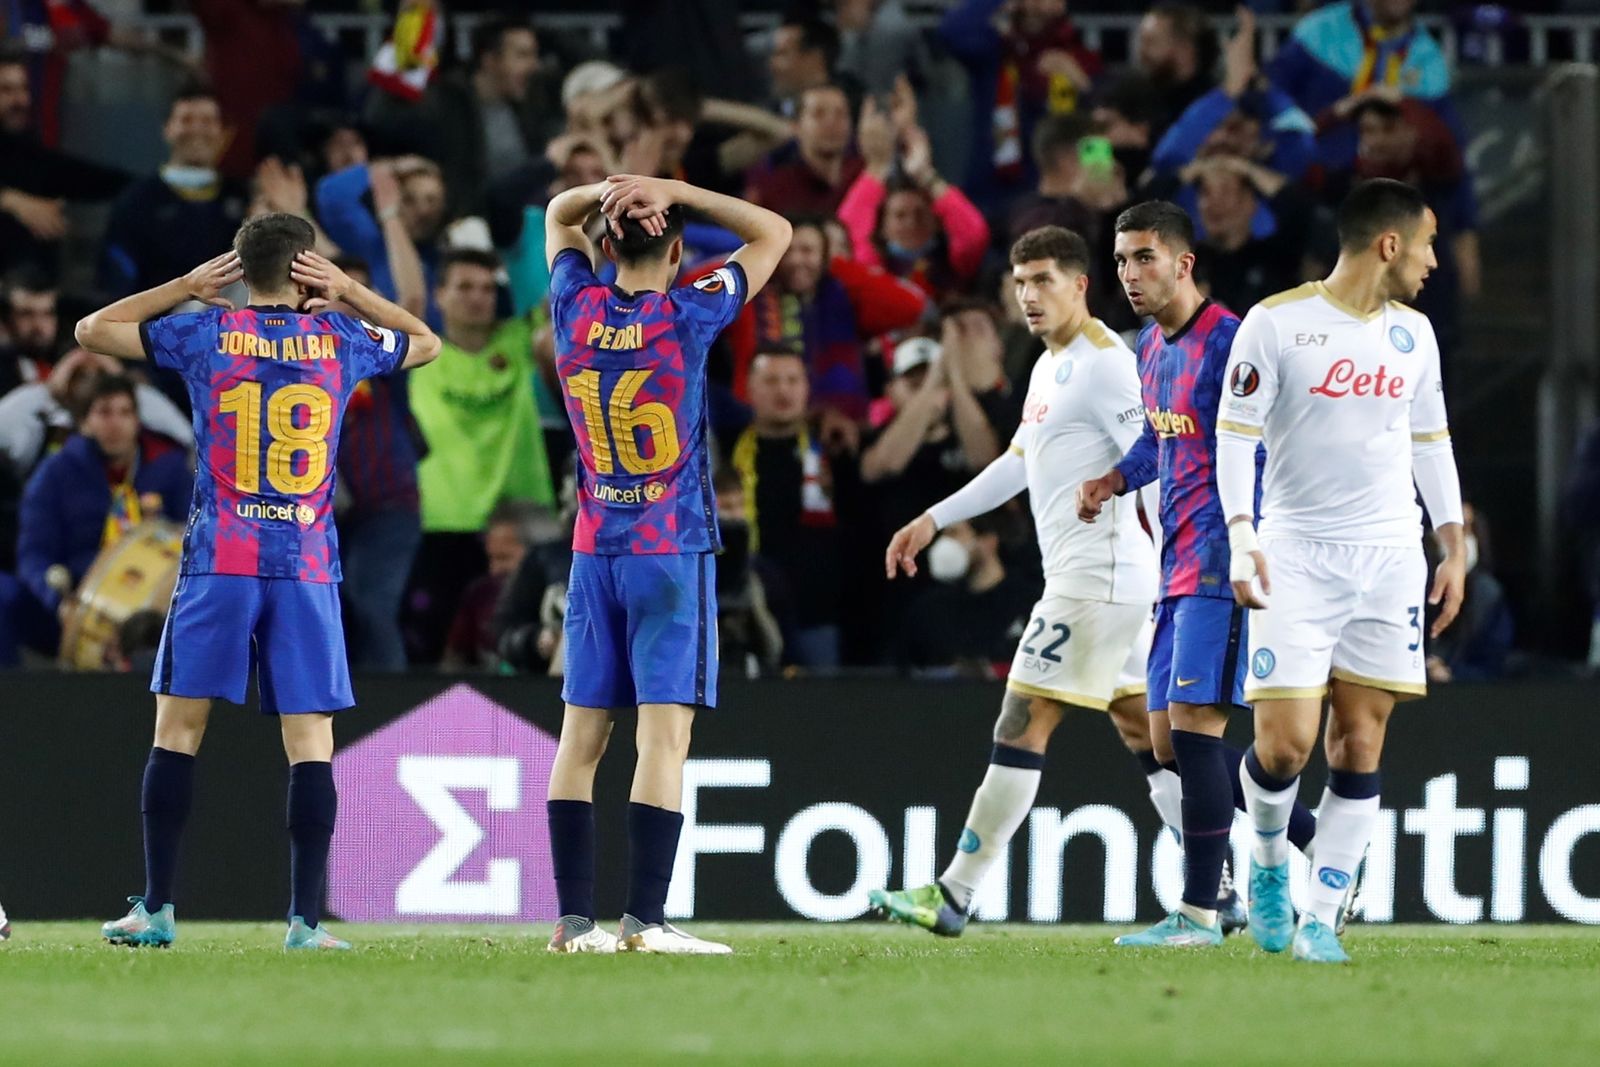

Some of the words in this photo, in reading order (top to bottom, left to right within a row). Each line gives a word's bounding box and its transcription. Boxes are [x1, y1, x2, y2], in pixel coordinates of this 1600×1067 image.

[217, 330, 278, 360] JORDI
[282, 335, 337, 362] ALBA
[586, 321, 644, 350] PEDRI
[1295, 333, 1329, 347] EA7
[1309, 358, 1405, 399] Lete
[566, 368, 681, 475] 16
[218, 381, 333, 496] 18
[594, 481, 642, 504] unicef
[236, 500, 295, 522] unicef
[1022, 616, 1071, 663] 22
[1023, 656, 1051, 673] EA7
